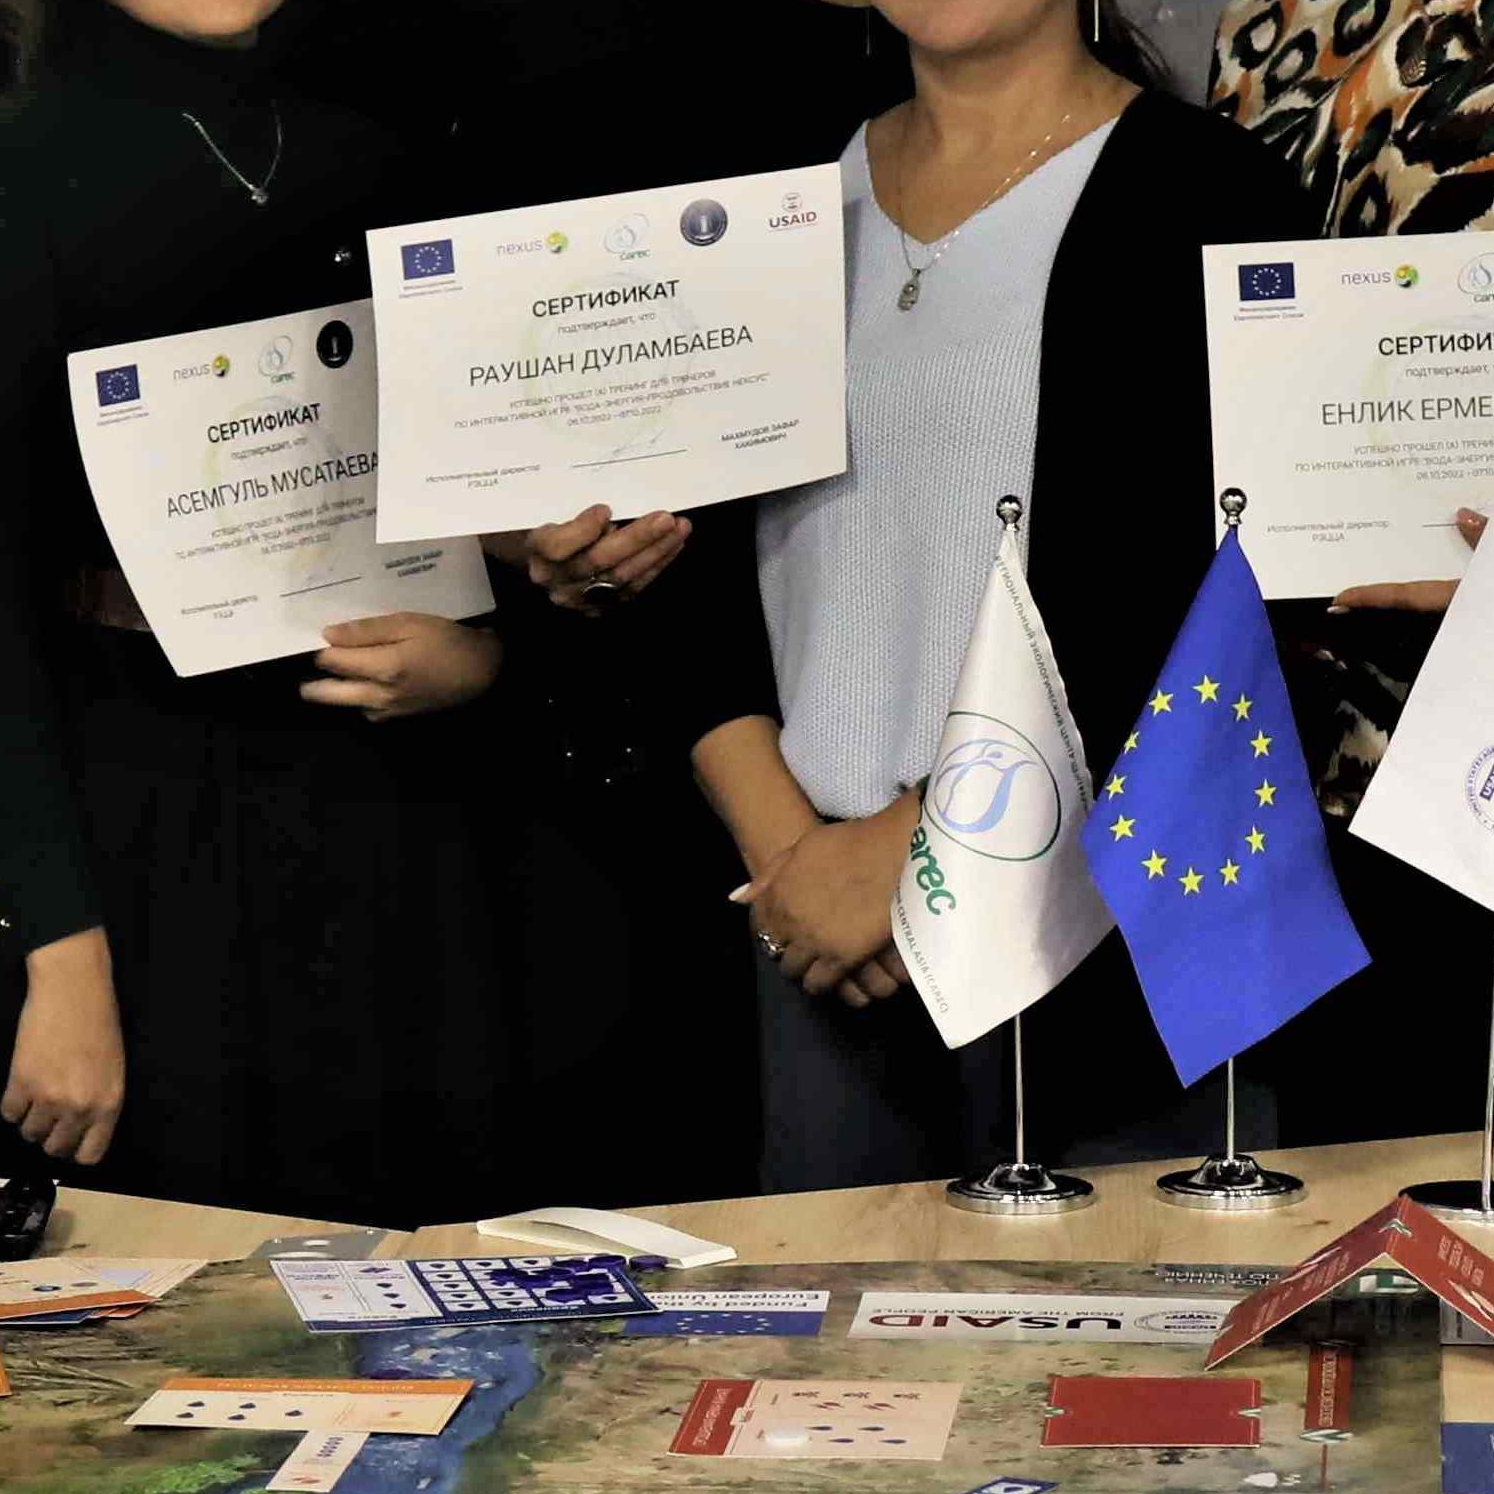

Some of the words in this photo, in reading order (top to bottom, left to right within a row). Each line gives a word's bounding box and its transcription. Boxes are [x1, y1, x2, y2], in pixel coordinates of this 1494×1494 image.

[768, 210, 818, 229] USAID
[496, 238, 544, 257] nexus
[1340, 269, 1392, 287] nexus
[531, 279, 682, 319] СЕРТИФИКАТ
[469, 353, 575, 388] РАУШАН
[581, 323, 754, 376] ДУЛАМБАЕВА
[172, 364, 211, 382] nexus
[1321, 398, 1416, 426] ЕНЛИК
[207, 403, 322, 444] СЕРТИФИКАТ
[166, 478, 270, 519] АСЕМГУЛЬ
[271, 450, 380, 495] МУСАТАЕВА
[896, 905, 917, 951] CENTRAL
[913, 950, 931, 975] ASIA
[685, 1299, 714, 1310] by
[709, 1291, 820, 1302] European
[720, 1300, 808, 1310] Funded
[869, 1314, 1123, 1330] USAID
